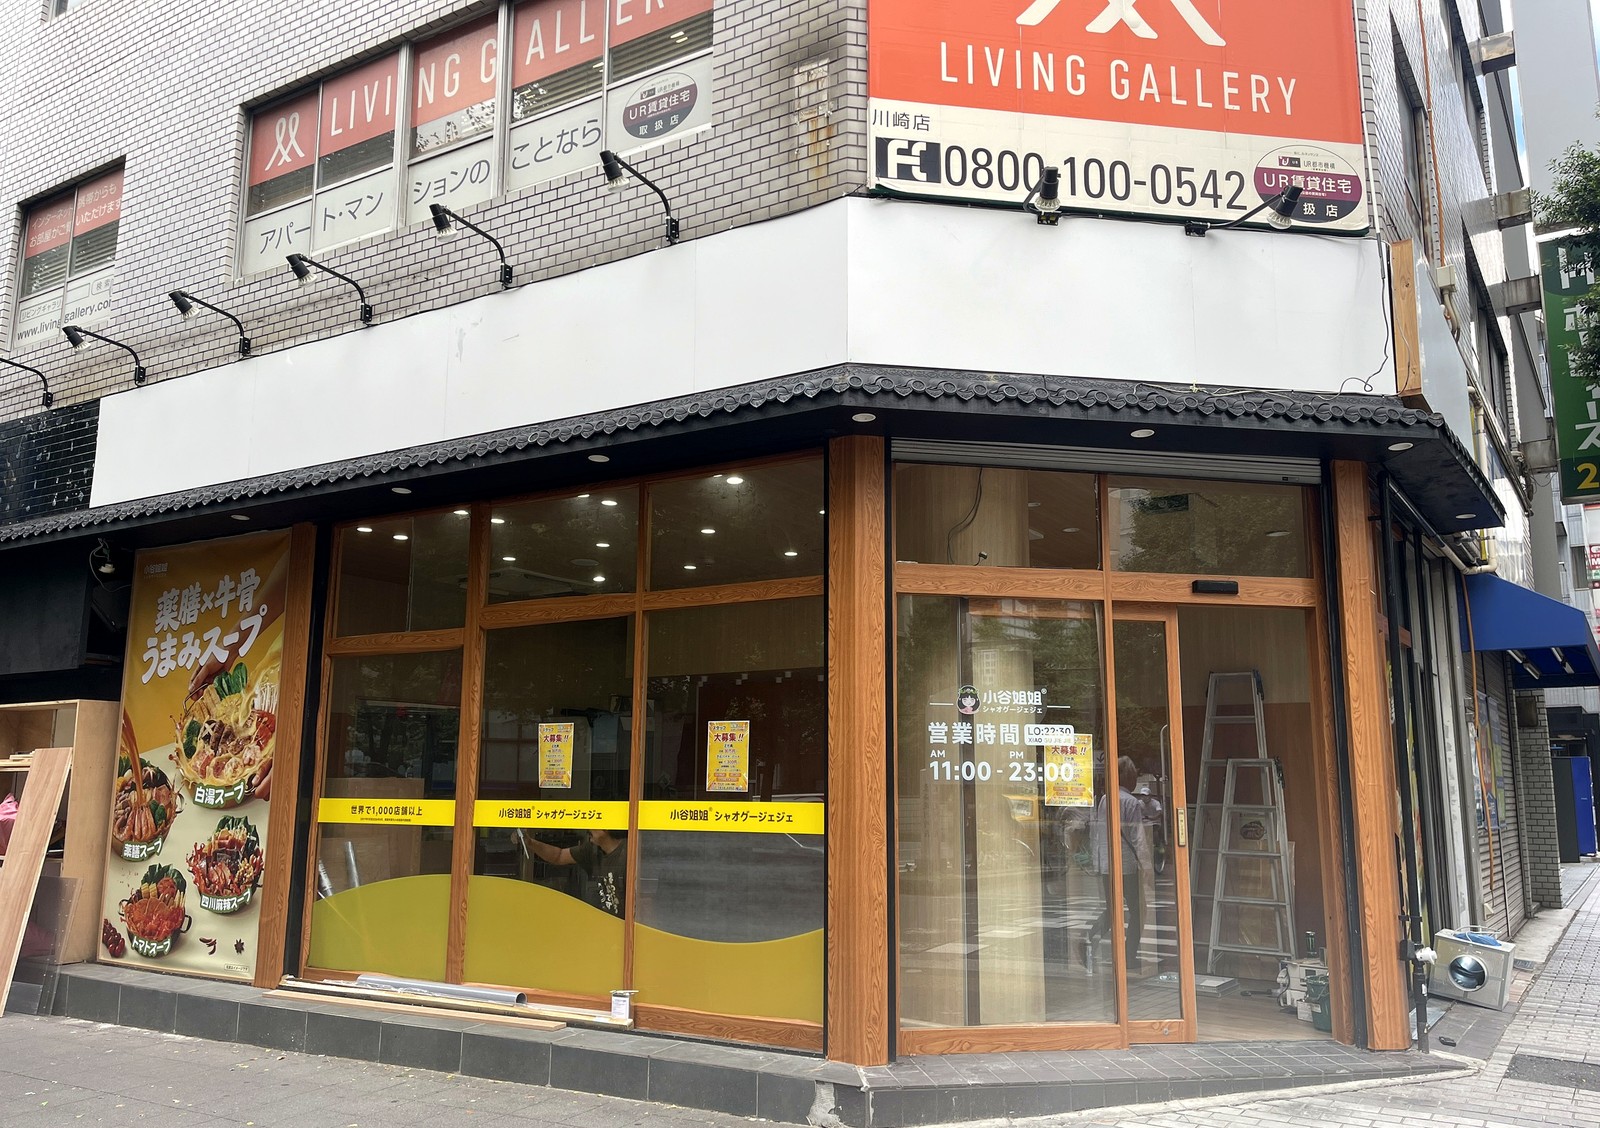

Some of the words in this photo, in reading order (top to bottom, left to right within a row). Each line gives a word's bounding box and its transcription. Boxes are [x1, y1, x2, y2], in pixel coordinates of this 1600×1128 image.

[941, 41, 1086, 96] LIVING
[1110, 59, 1296, 116] GALLERY
[629, 89, 690, 120] UR賃貸住宅
[638, 114, 679, 136] 取扱店
[872, 109, 931, 132] 川崎店
[944, 145, 1248, 211] 0800100-0542
[141, 604, 268, 685] うまみスープ
[982, 705, 1043, 714] シャオグージェジェ
[928, 721, 1020, 746] 営業時間
[930, 750, 946, 758] AM
[1009, 751, 1024, 759] PM
[929, 760, 992, 782] 11:00
[1008, 762, 1075, 782] 23:00
[194, 781, 246, 805] 白湯スープ
[536, 809, 603, 821] シャオグージェジェ
[714, 810, 794, 824] シャオグージェジェ
[131, 938, 171, 954] トマトスープ
